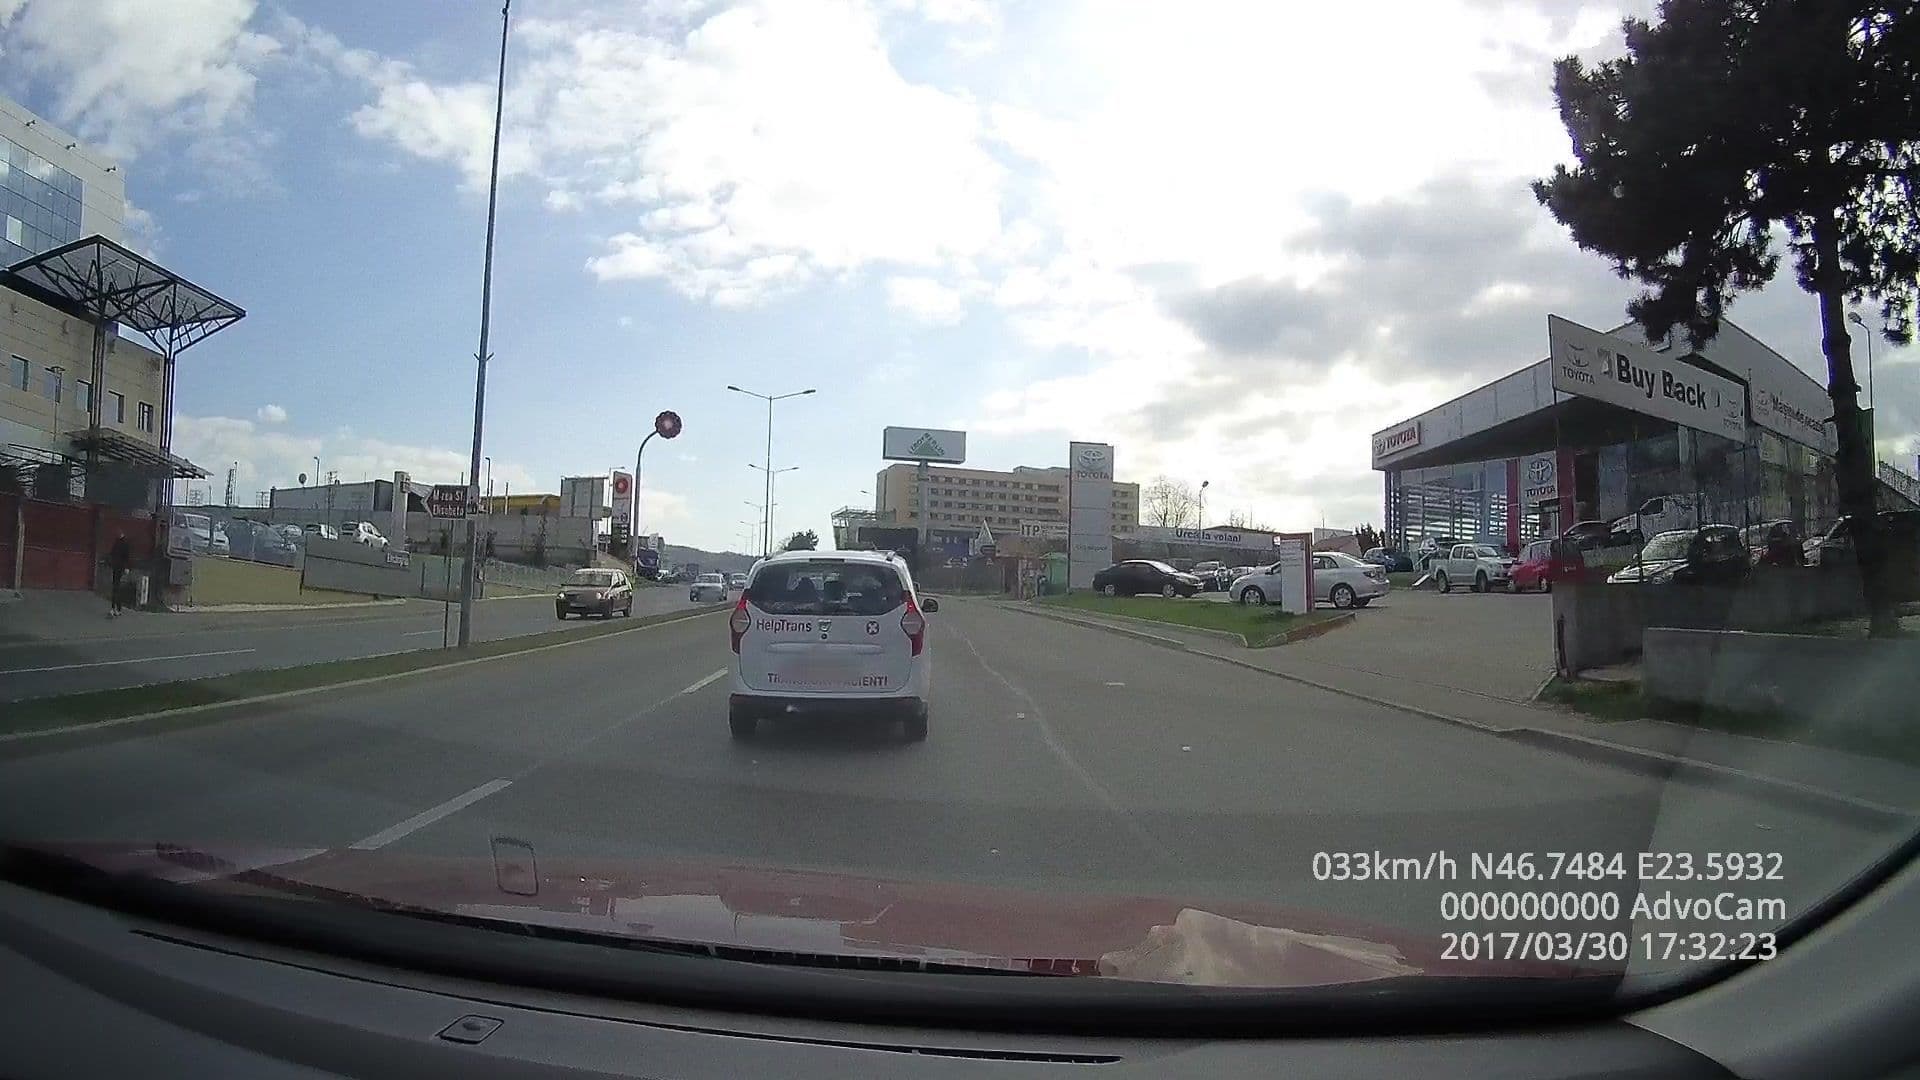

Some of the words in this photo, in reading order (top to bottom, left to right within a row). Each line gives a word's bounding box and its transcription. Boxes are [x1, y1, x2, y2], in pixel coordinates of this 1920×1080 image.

[1562, 365, 1596, 385] TOYOTA
[1615, 352, 1656, 399] Buy
[1662, 369, 1707, 410] Back
[1386, 426, 1417, 450] TOYOTA
[1076, 470, 1110, 480] TOYOTA
[1525, 484, 1557, 498] TOYOTA
[1021, 523, 1041, 536] ITP
[1202, 531, 1211, 541] la
[756, 618, 812, 634] HelpTrans
